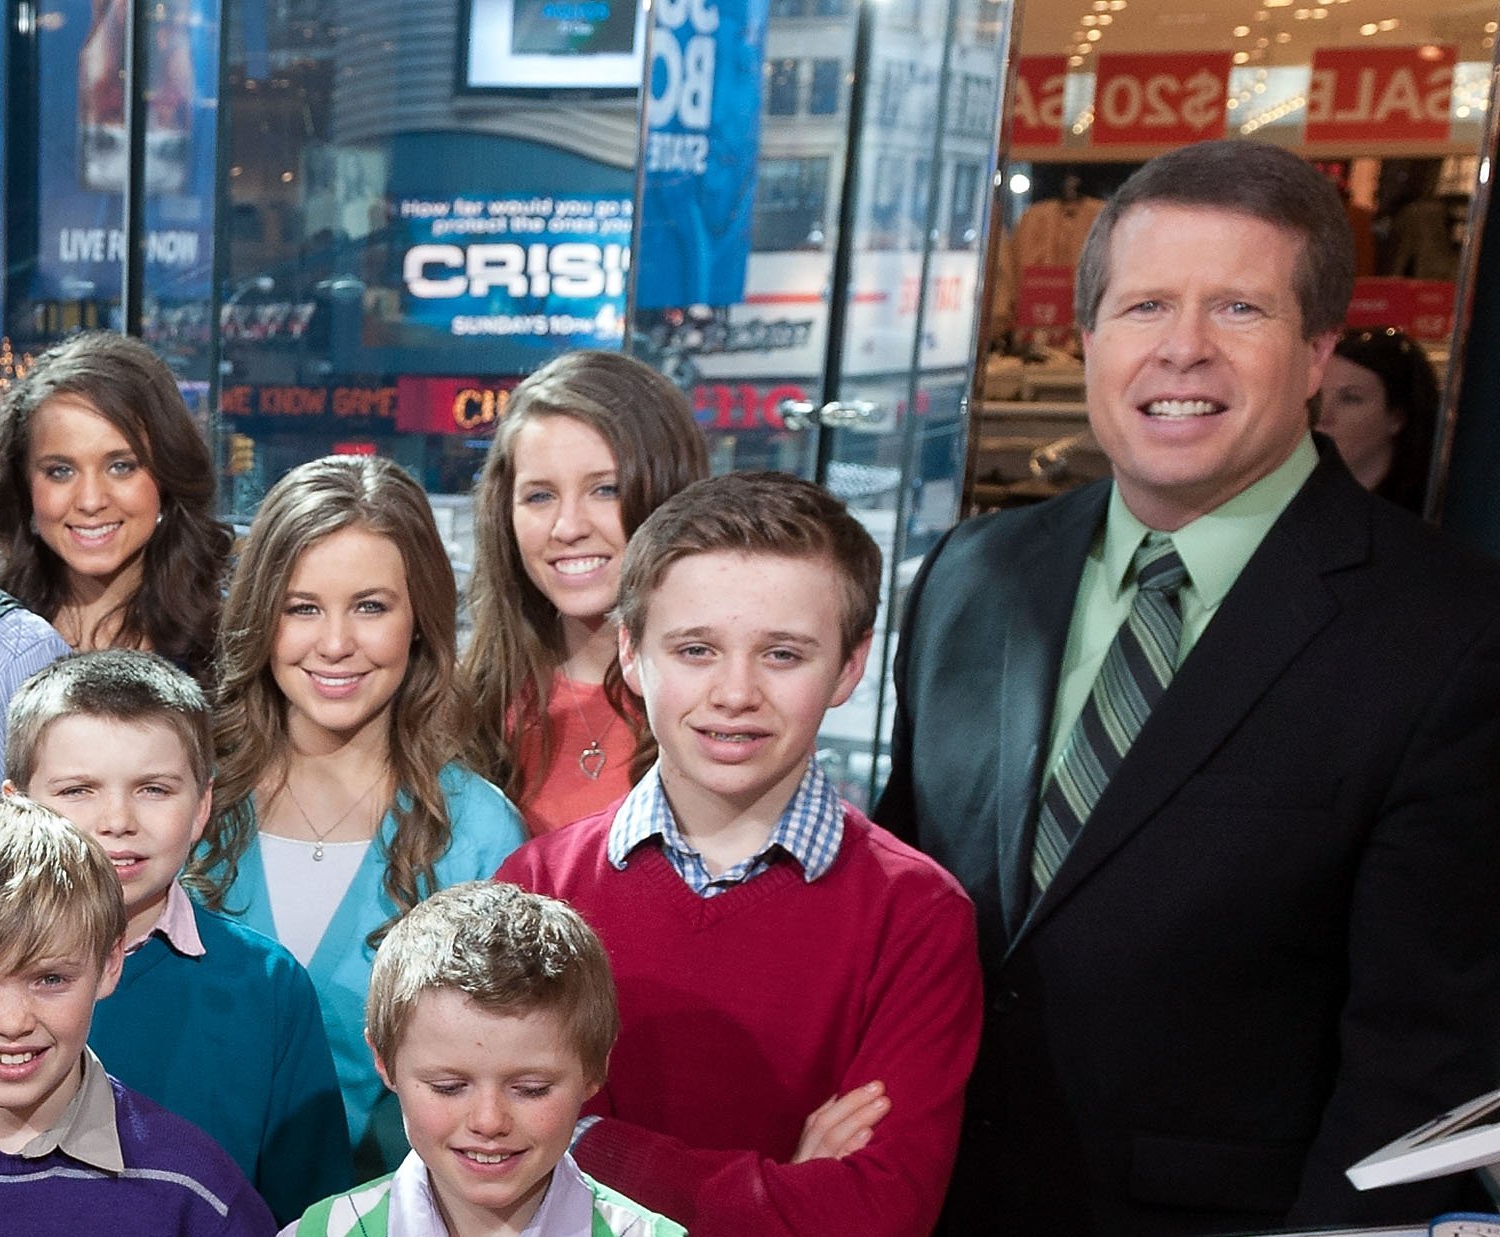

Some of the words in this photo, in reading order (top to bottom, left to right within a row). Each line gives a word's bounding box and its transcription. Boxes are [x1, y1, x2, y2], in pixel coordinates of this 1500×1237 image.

[402, 199, 450, 218] How
[454, 198, 483, 217] far
[487, 197, 553, 217] would
[555, 200, 593, 218] you
[595, 200, 620, 218] go
[432, 216, 507, 236] protect
[510, 216, 545, 233] the
[548, 218, 598, 233] ones
[59, 228, 105, 262] LIVE
[149, 231, 199, 264] NOW
[403, 243, 630, 298] CRISI
[452, 314, 548, 335] SUNDAYS
